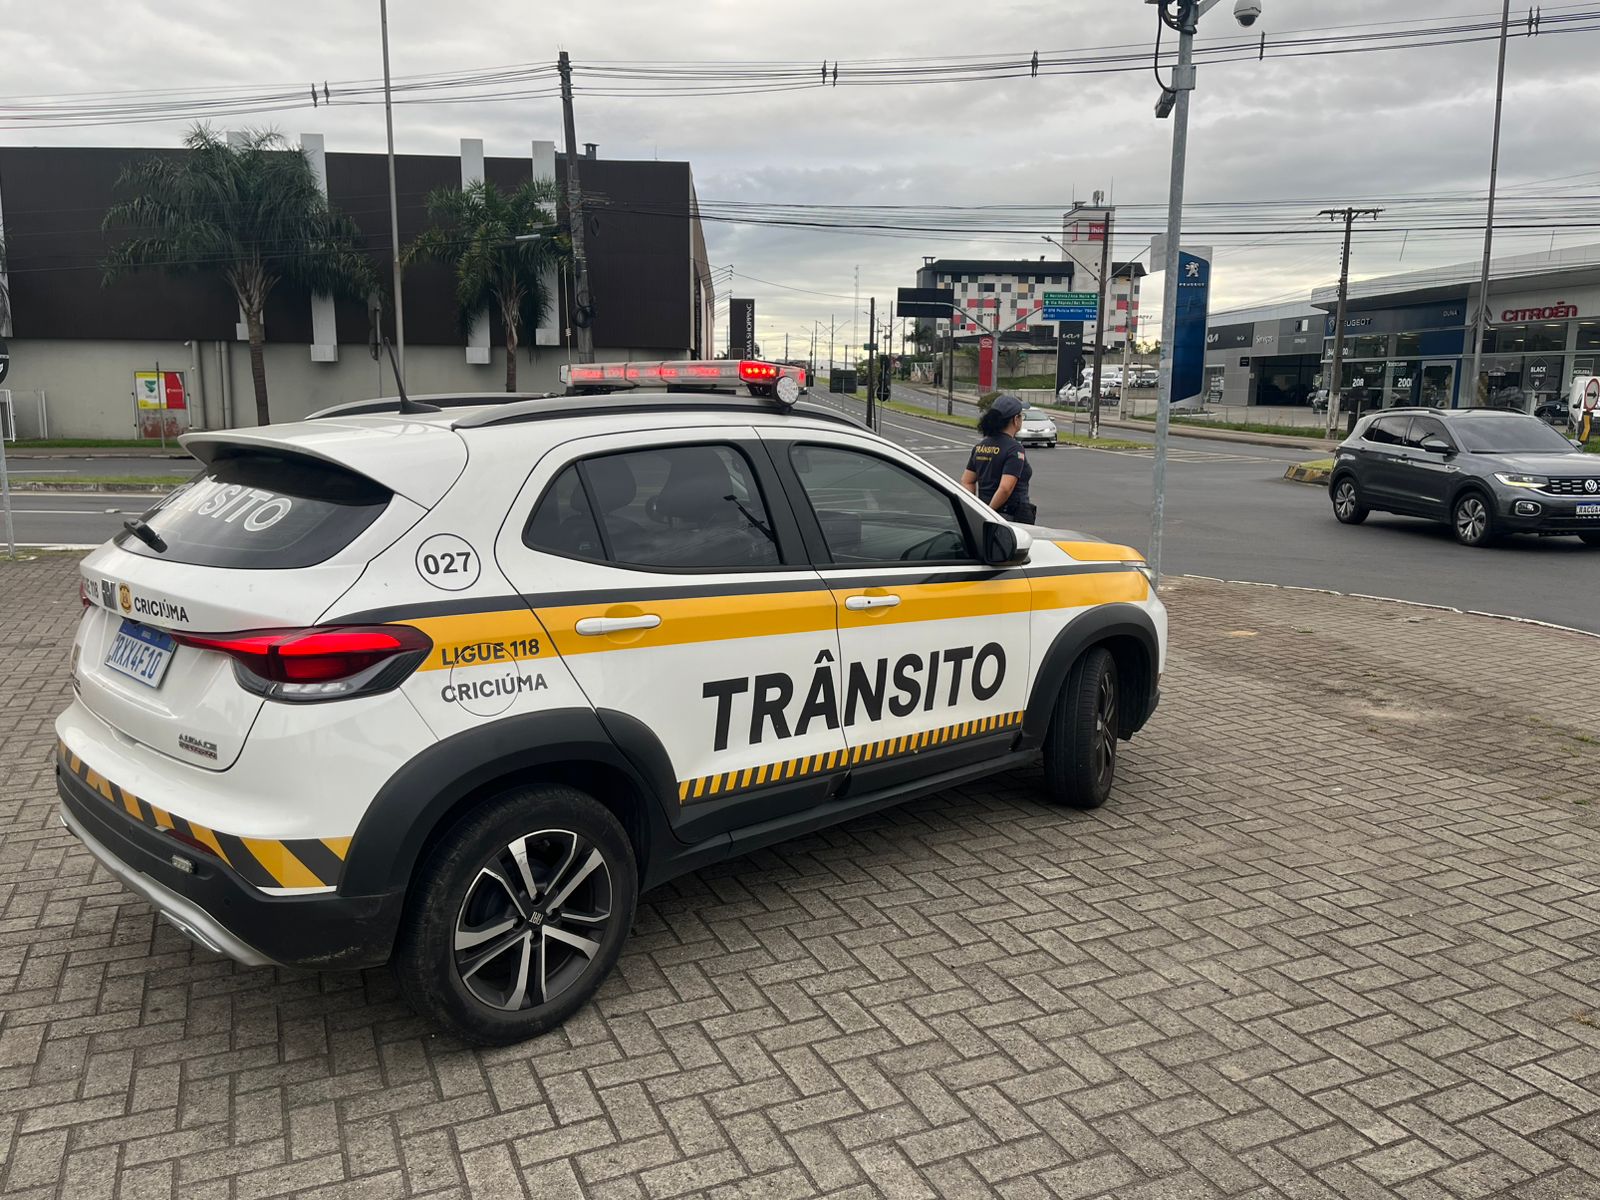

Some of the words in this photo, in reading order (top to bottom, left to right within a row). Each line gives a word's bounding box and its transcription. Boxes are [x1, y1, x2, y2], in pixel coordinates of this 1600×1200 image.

[1343, 317, 1371, 327] EUGEOT
[1501, 301, 1578, 321] CITROËN
[423, 551, 471, 575] 027
[134, 597, 190, 623] CRICIÚMA
[441, 642, 505, 666] LIGUE
[509, 638, 540, 657] 118
[441, 672, 548, 703] CRICIÚMA
[702, 641, 1007, 753] TRÂNSITO
